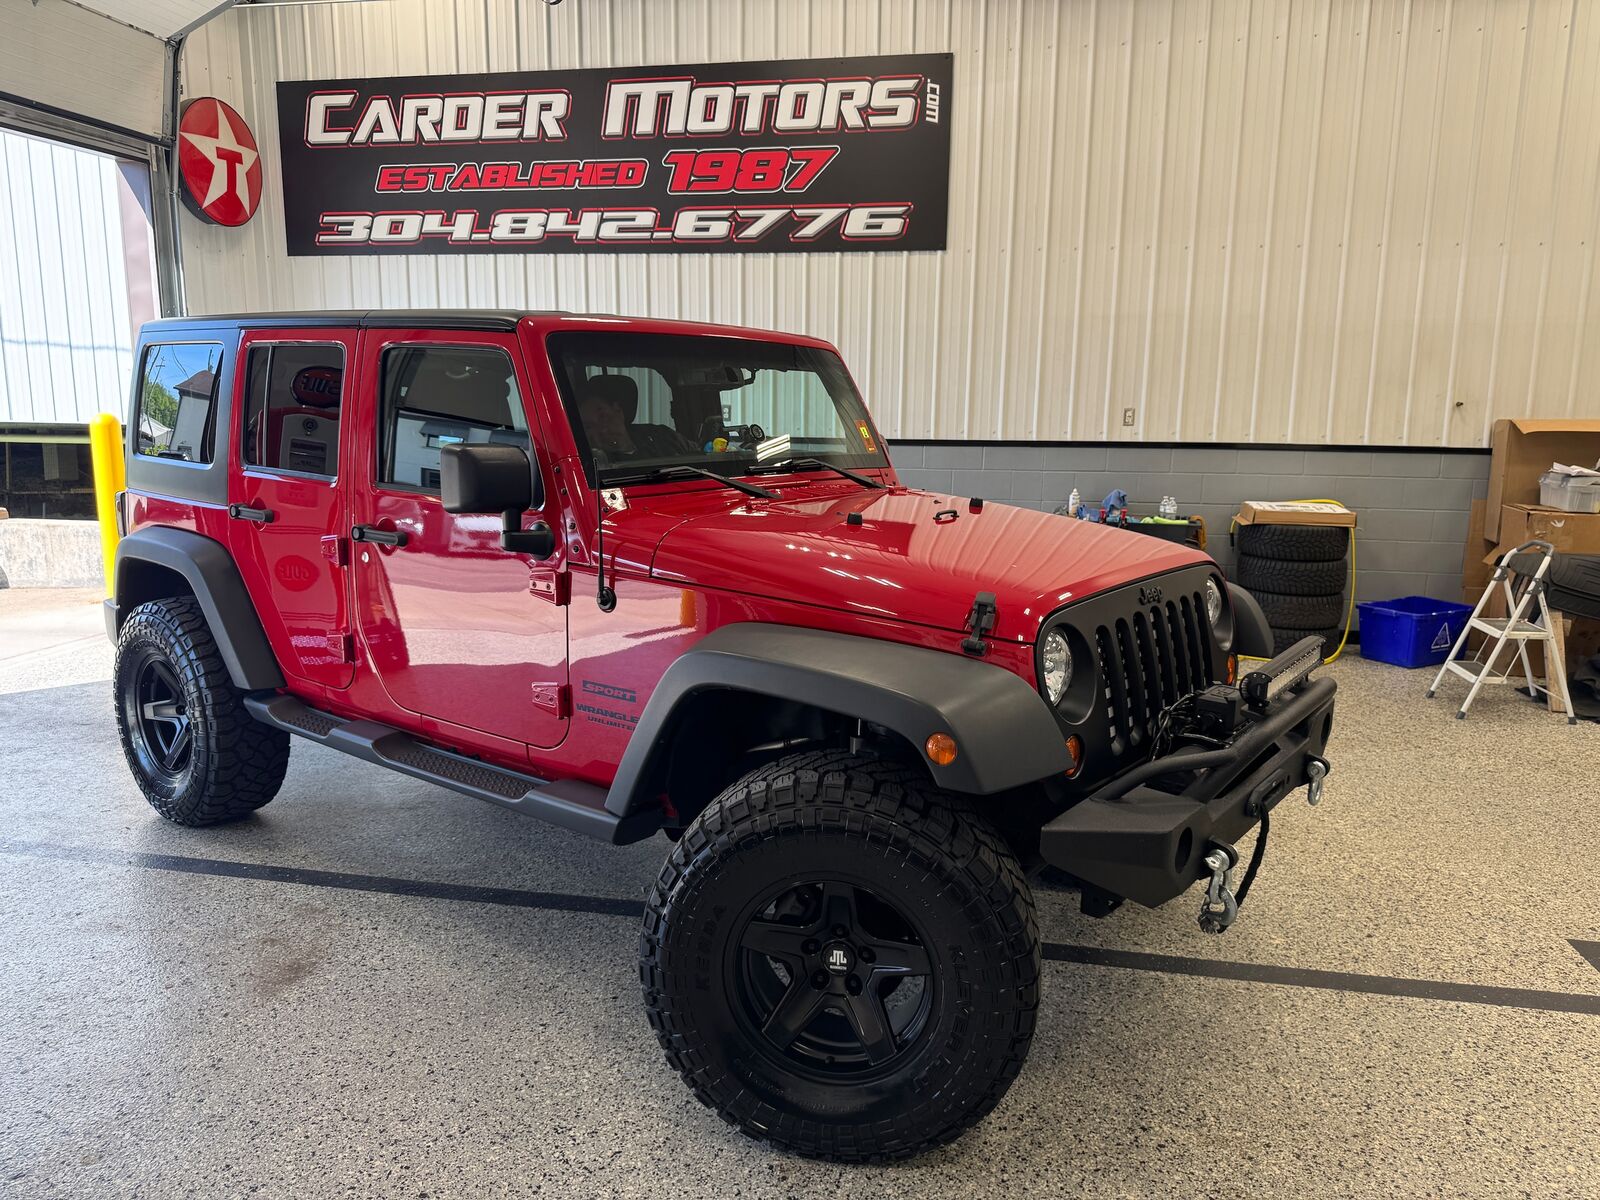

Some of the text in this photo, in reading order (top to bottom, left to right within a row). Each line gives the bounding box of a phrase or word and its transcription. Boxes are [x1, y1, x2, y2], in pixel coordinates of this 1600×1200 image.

[305, 75, 924, 148] CARDER MOTORS
[216, 146, 243, 194] T
[375, 145, 840, 195] ESTABLISHED 1987
[315, 202, 913, 246] 304.842.6776
[1139, 586, 1163, 605] Jeep
[583, 681, 636, 702] SPORT
[576, 703, 640, 723] WRANGLE
[588, 716, 636, 732] UNLIMITE
